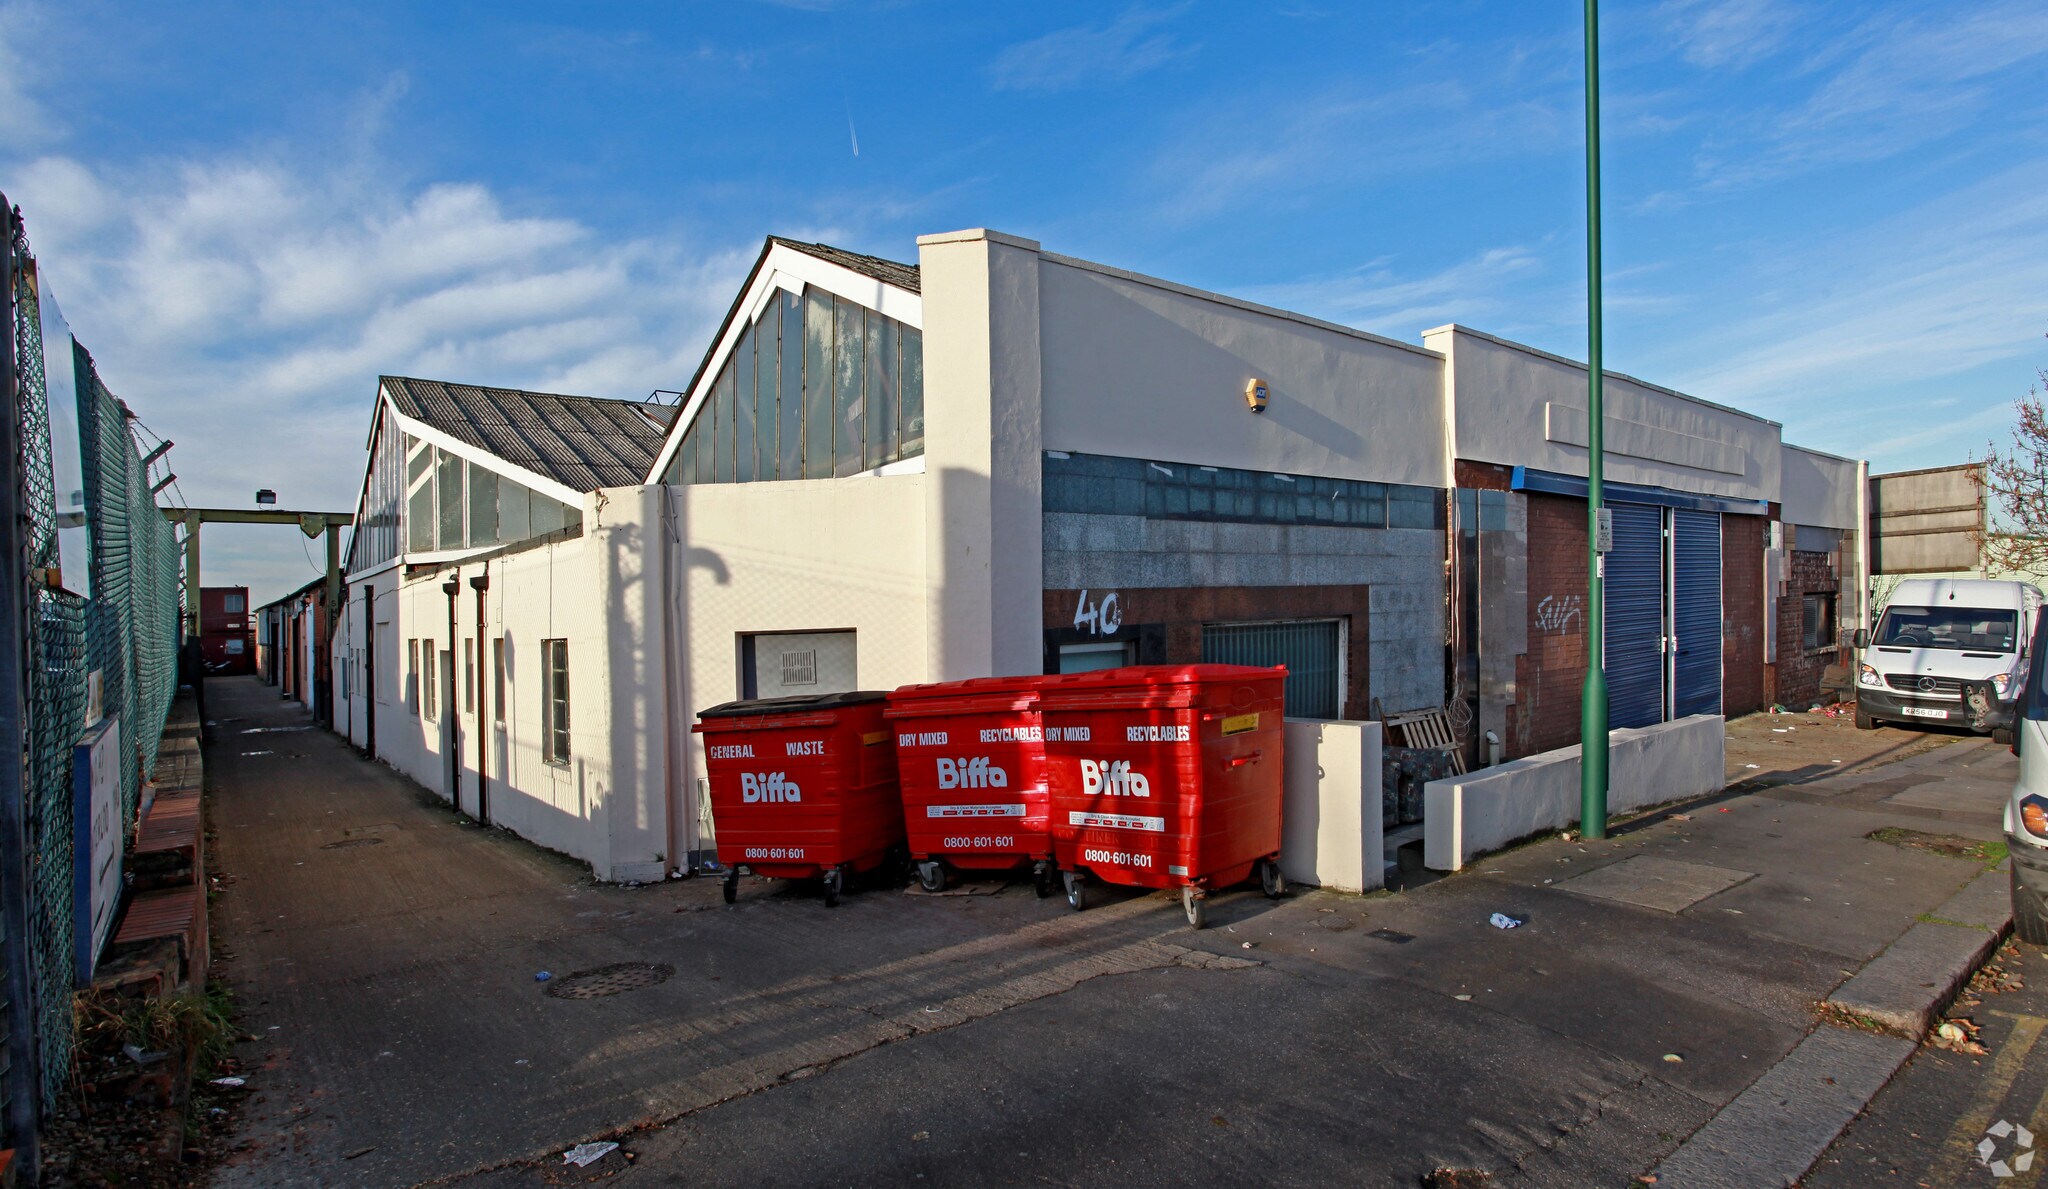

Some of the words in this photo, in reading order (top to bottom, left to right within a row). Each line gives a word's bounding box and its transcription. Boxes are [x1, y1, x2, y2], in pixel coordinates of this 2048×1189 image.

[1073, 589, 1121, 635] 40
[710, 744, 755, 759] GENERAL
[786, 740, 824, 756] WASTE
[899, 734, 916, 747] DRY
[919, 731, 948, 746] MIXED
[980, 726, 1042, 743] RECYCLABLES
[1045, 727, 1062, 742] DRY
[1063, 726, 1091, 742] MIXED
[1126, 725, 1190, 742] RECYCLABLES
[741, 771, 801, 803] Biffa
[936, 756, 1008, 790] Biffa
[1080, 759, 1150, 798] Biffa
